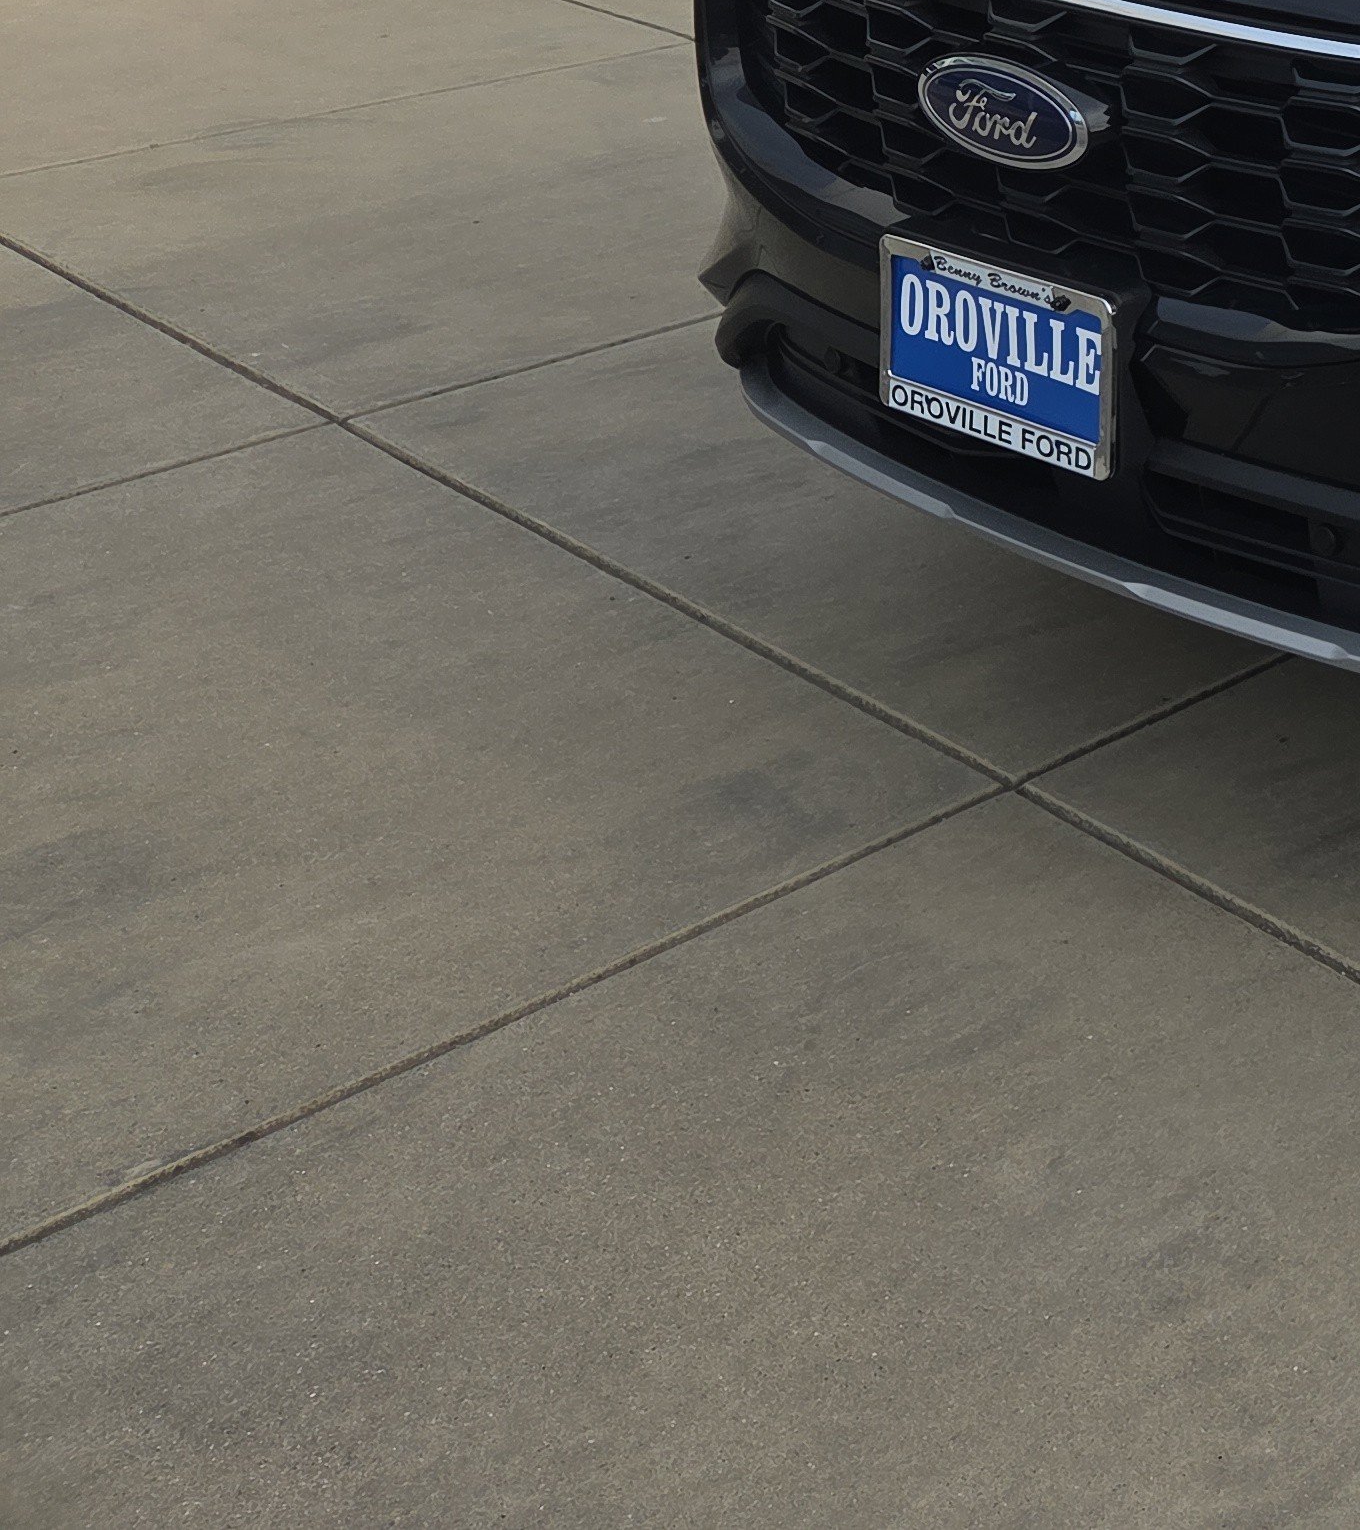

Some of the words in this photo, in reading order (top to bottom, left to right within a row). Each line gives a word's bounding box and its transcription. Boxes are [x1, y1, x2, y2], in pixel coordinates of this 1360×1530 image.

[947, 78, 1039, 150] Ford
[934, 255, 983, 286] Benny
[987, 272, 1052, 304] Brown's
[900, 272, 1102, 396] OROVILLE
[970, 356, 1029, 407] FORD
[891, 384, 1012, 446] OROVILLE
[1021, 427, 1092, 471] FORD
